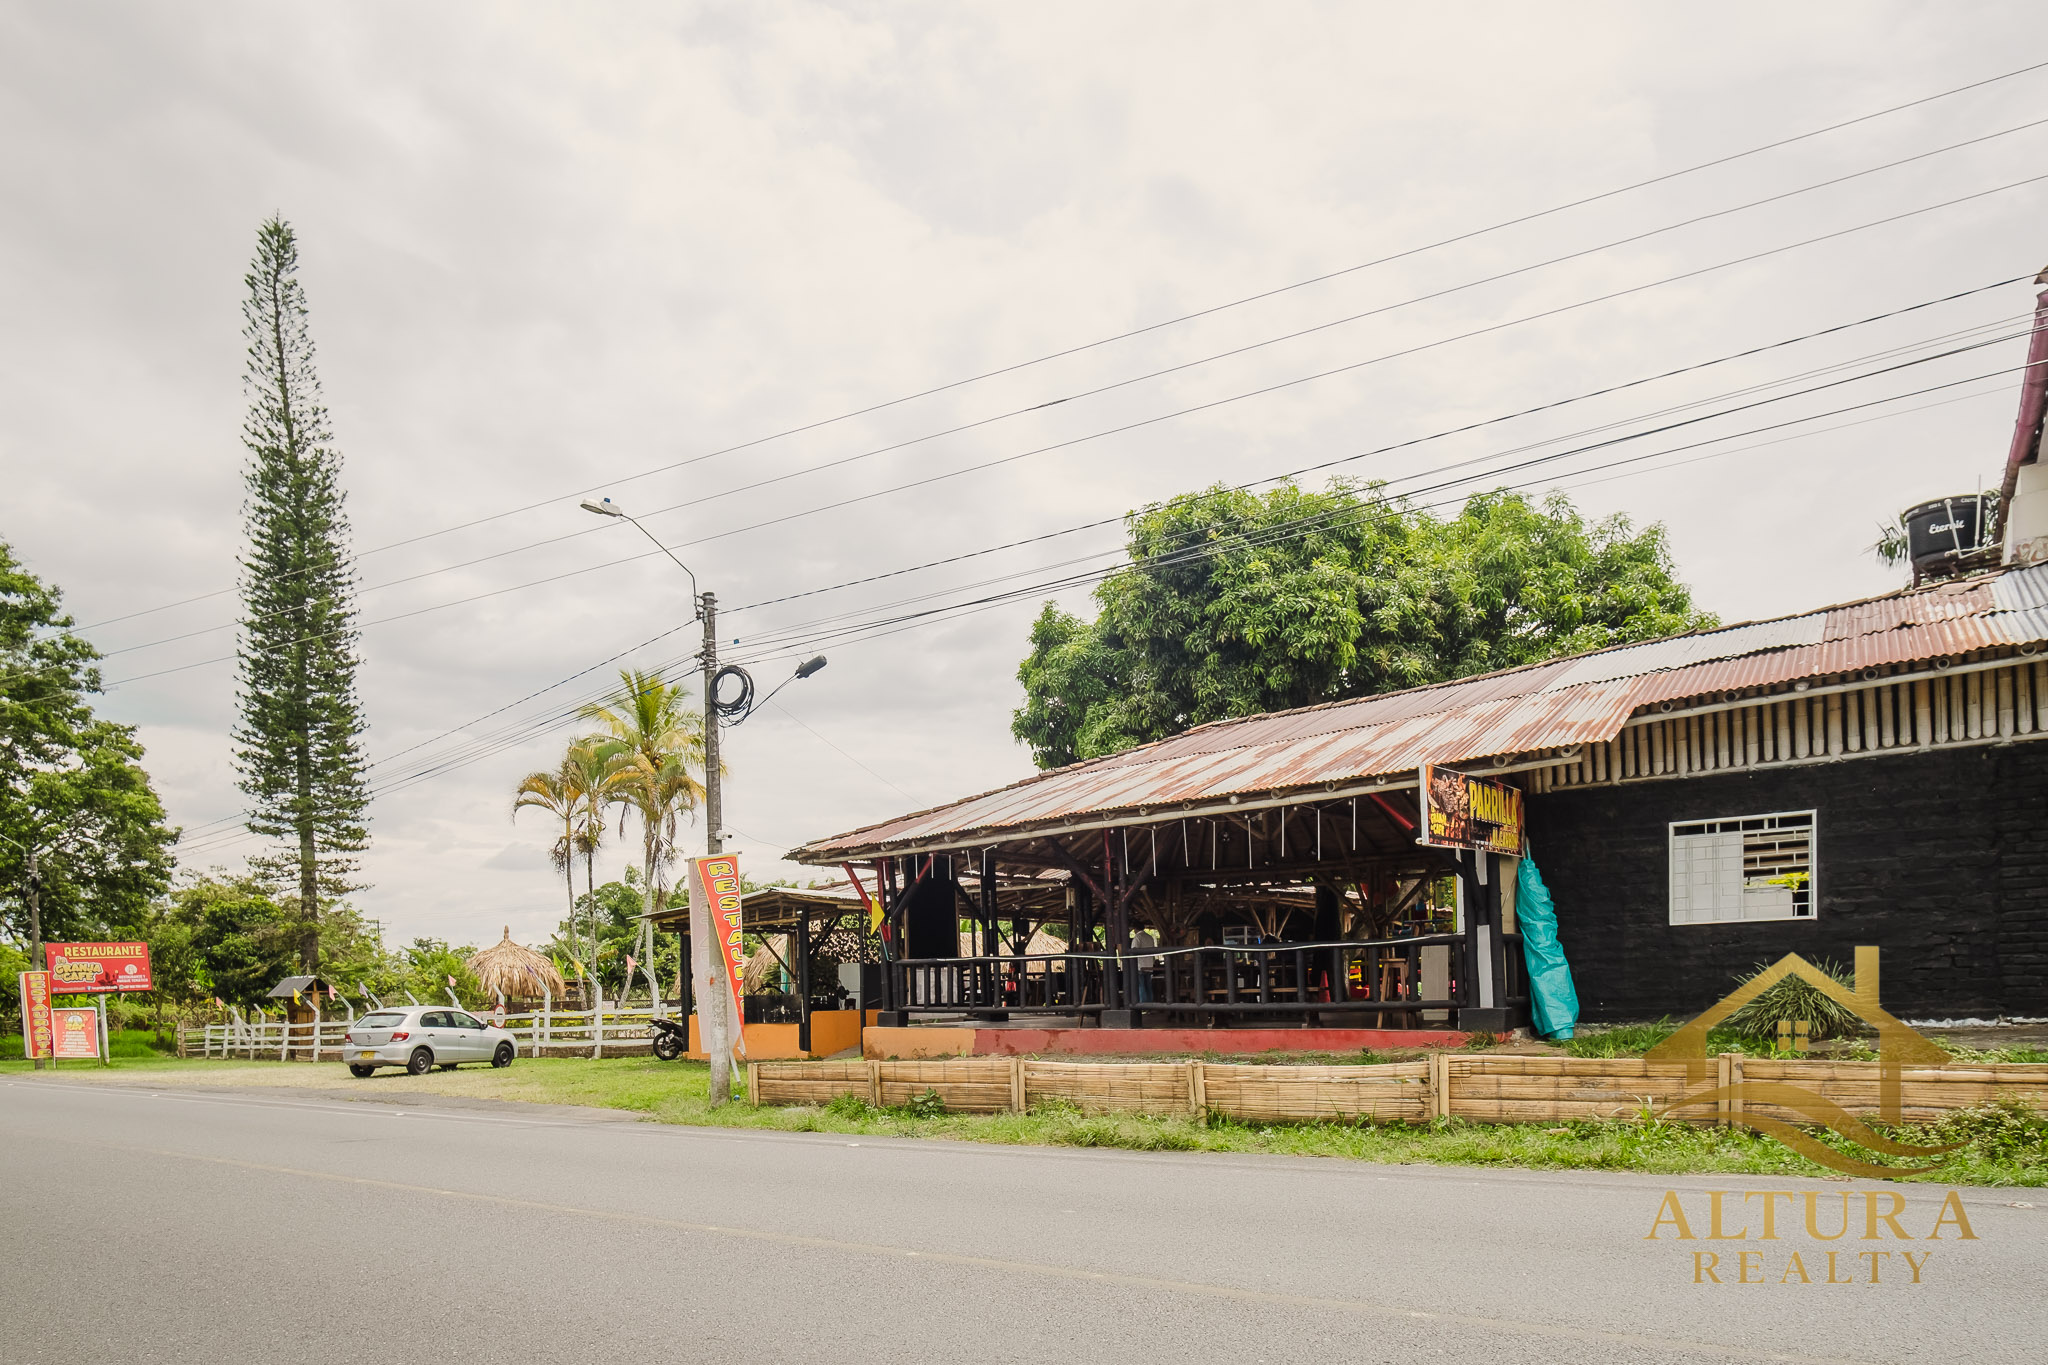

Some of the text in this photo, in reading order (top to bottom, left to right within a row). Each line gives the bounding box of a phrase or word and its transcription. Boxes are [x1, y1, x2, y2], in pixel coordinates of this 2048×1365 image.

[1469, 780, 1518, 828] PARRILLA
[64, 946, 142, 957] RESTAURANTE
[707, 861, 745, 1015] RESTAU
